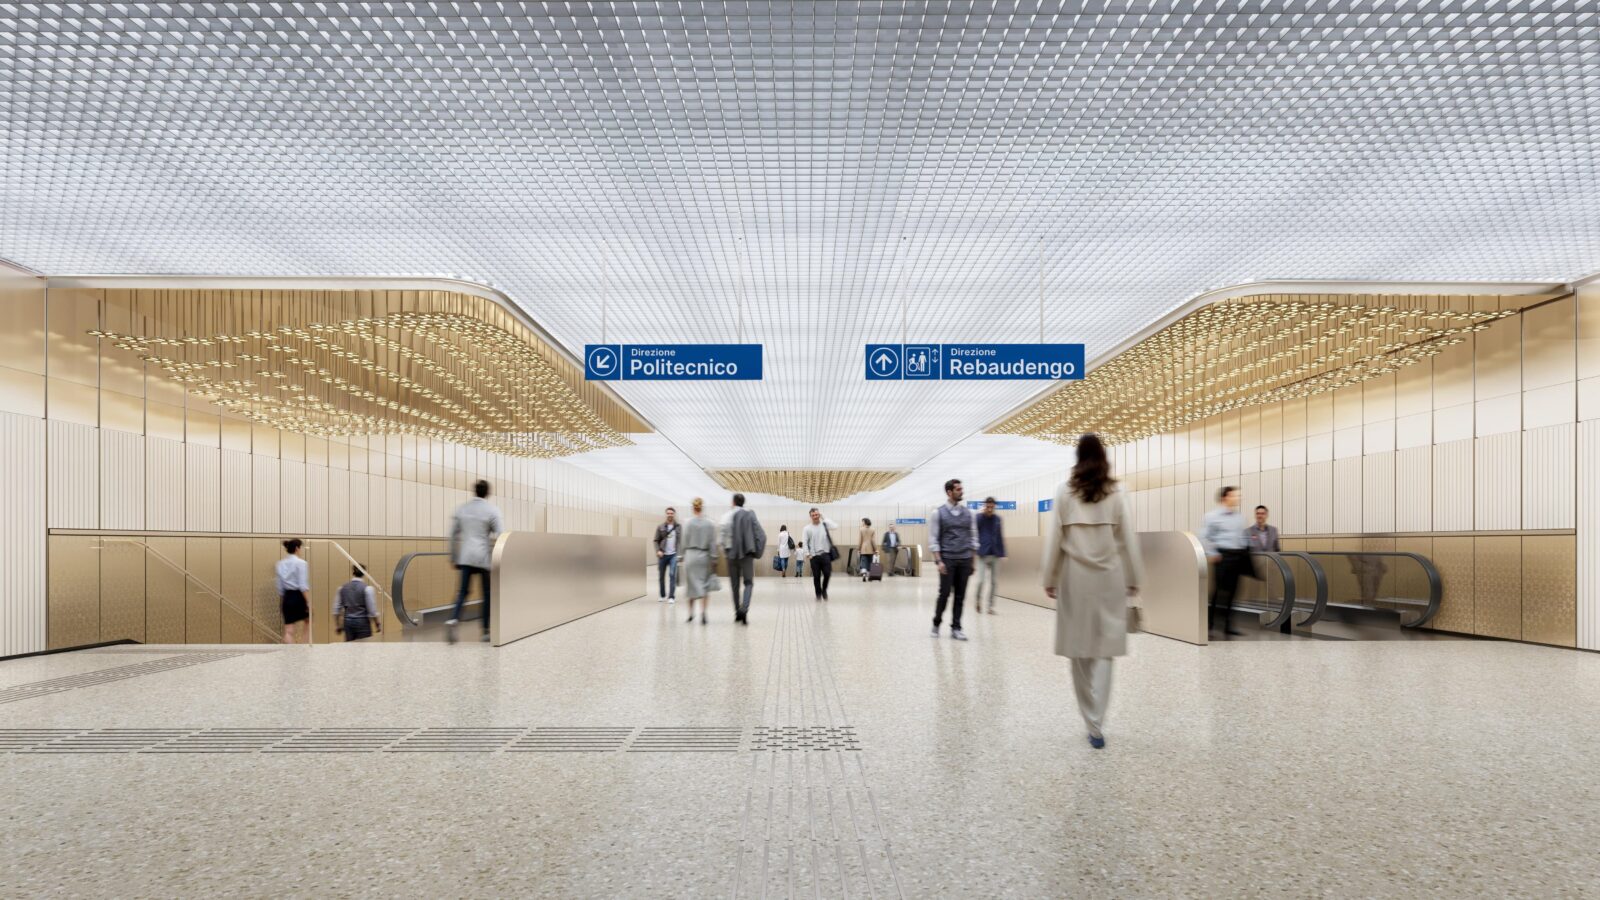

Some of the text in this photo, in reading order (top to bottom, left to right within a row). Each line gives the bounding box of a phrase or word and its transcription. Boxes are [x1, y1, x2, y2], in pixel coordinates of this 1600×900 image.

[631, 348, 676, 357] Direzione
[950, 348, 996, 356] Direzione
[630, 358, 738, 376] Politecnico
[950, 358, 1075, 379] Rebaudengo
